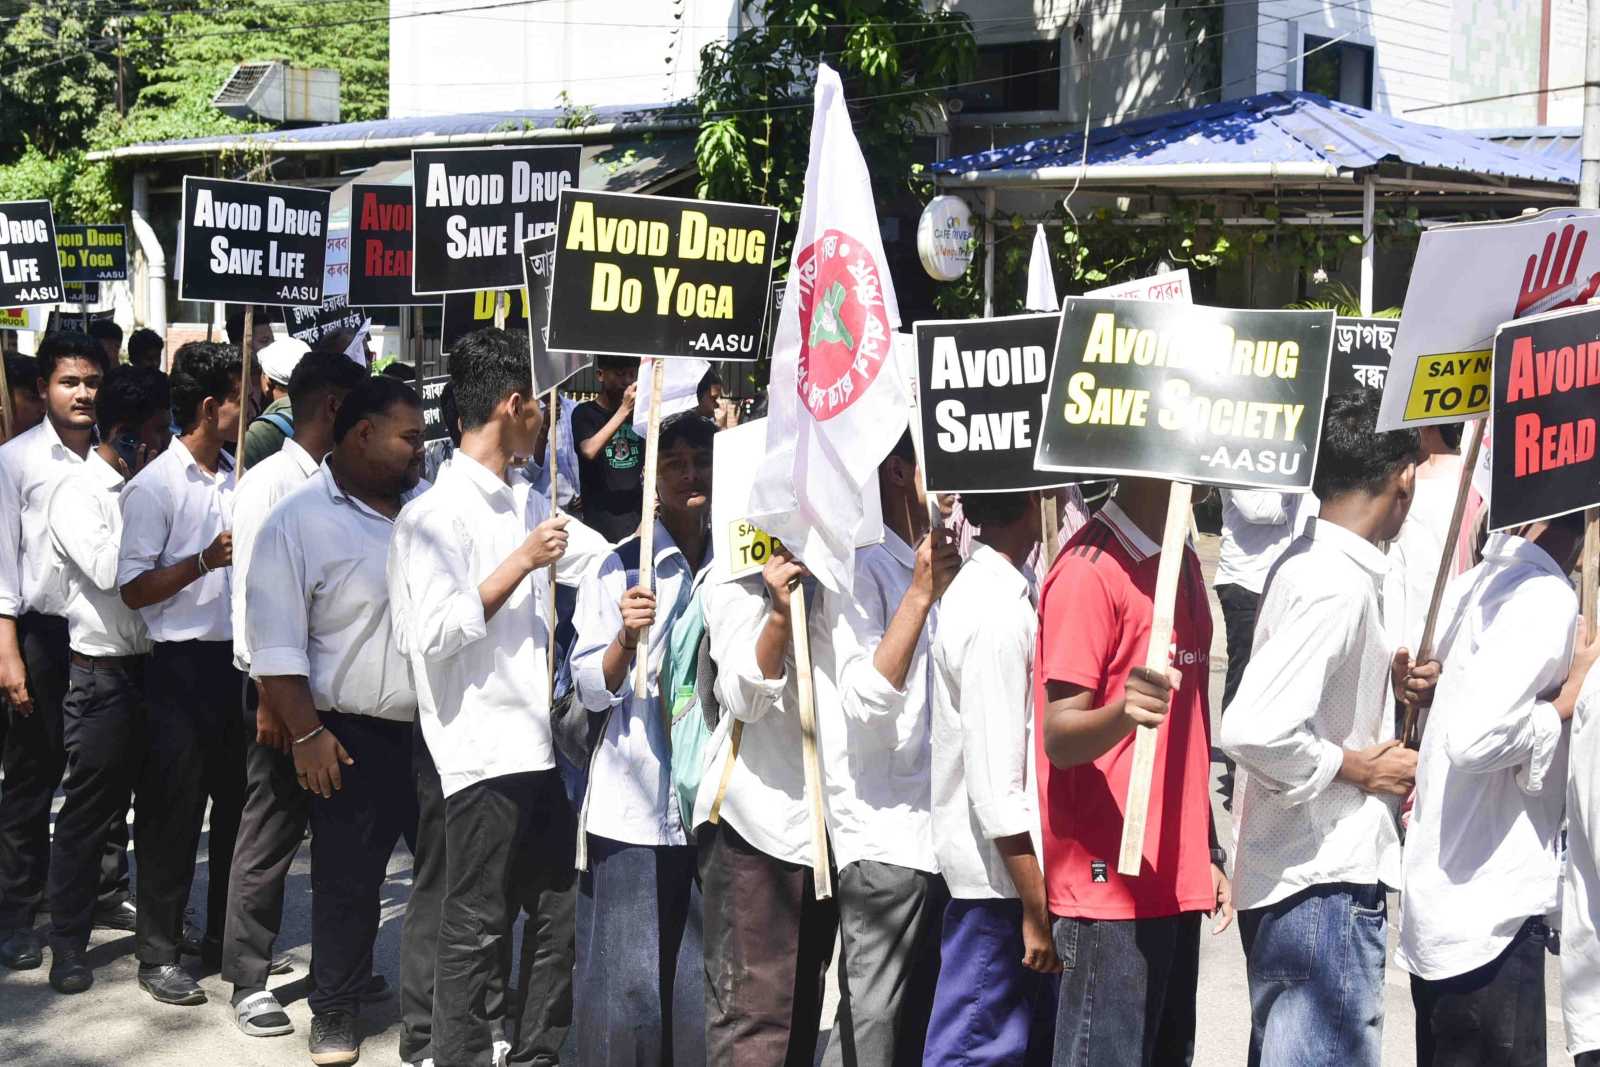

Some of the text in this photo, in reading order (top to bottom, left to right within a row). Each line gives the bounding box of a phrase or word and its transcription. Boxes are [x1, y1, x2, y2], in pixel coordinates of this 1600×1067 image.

[425, 161, 571, 207] AVOID DRUG
[193, 189, 322, 237] AVOID DRUG
[359, 192, 413, 232] AVOI
[57, 229, 122, 247] VOID DRUG
[446, 214, 507, 260] SAVE
[565, 201, 766, 265] AVOID DRUG
[0, 250, 41, 283] LIFE
[79, 249, 113, 267] YOGA
[210, 235, 305, 279] SAVE LIFE
[15, 286, 59, 302] -AASU
[276, 285, 319, 300] -AASU
[590, 262, 642, 314] DO
[653, 266, 734, 320] YOGA
[689, 333, 753, 353] -AASU
[930, 336, 1046, 390] AVOID
[1428, 356, 1492, 377] SAY N
[1064, 372, 1305, 442] SAVE SOCIETY
[1423, 386, 1462, 413] TO
[935, 399, 1031, 453] SAVE
[1514, 412, 1597, 479] READ
[1200, 446, 1301, 476] -AASU
[739, 541, 766, 564] TO
